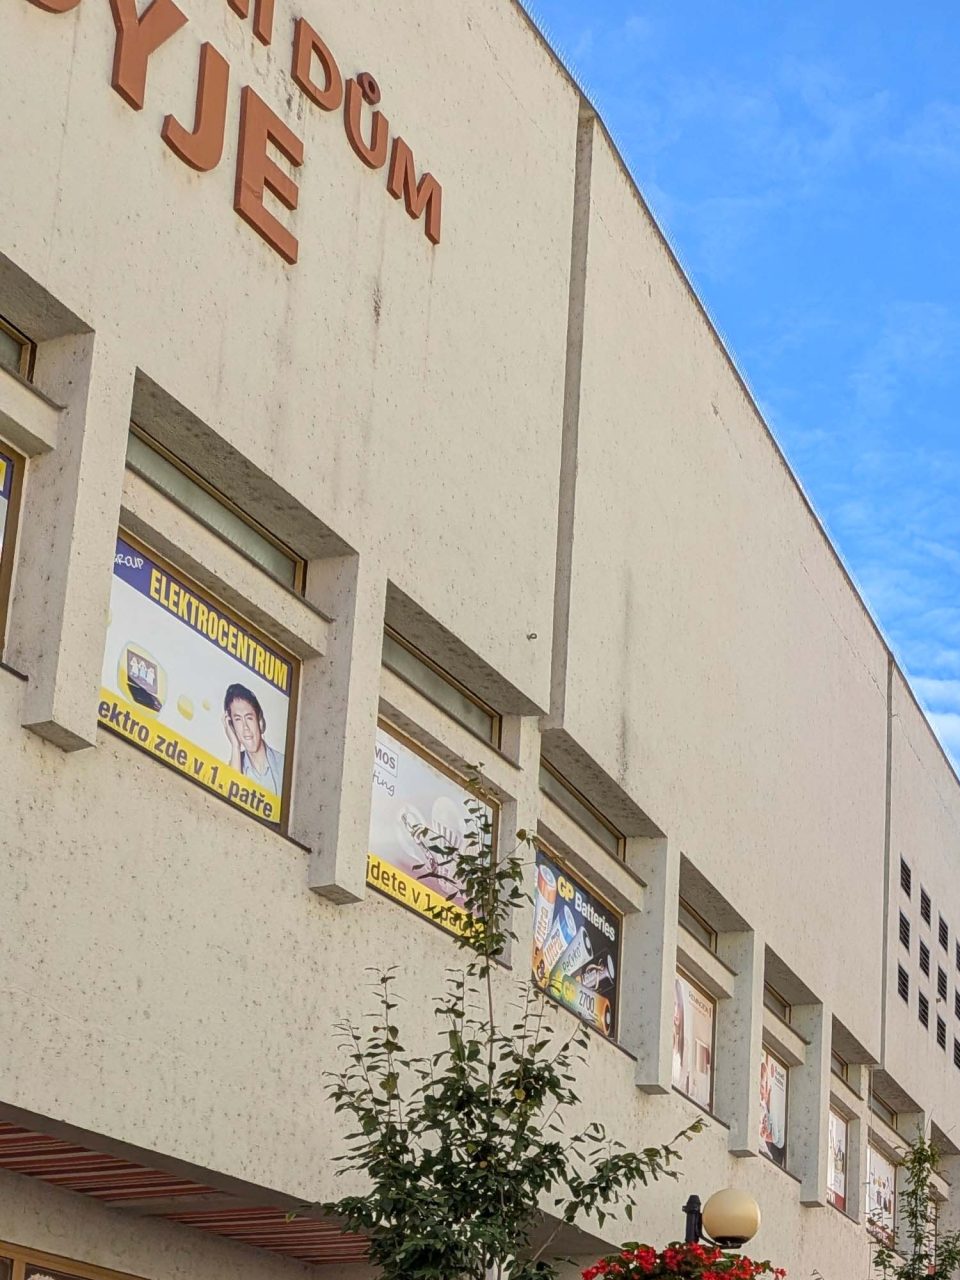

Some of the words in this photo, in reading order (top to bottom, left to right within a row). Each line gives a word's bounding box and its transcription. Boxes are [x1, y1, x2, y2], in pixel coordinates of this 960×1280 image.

[27, 0, 304, 265] YJE
[291, 17, 442, 245] DŮM
[150, 568, 288, 691] ELEKTROCENTRUM
[98, 700, 150, 743] ektro
[154, 735, 187, 766] zde
[193, 759, 205, 776] v
[210, 765, 223, 790] 1.
[229, 779, 273, 818] patře
[412, 888, 421, 904] v
[557, 875, 575, 902] GP
[574, 891, 616, 942] Batteries
[578, 989, 596, 1014] 2700
